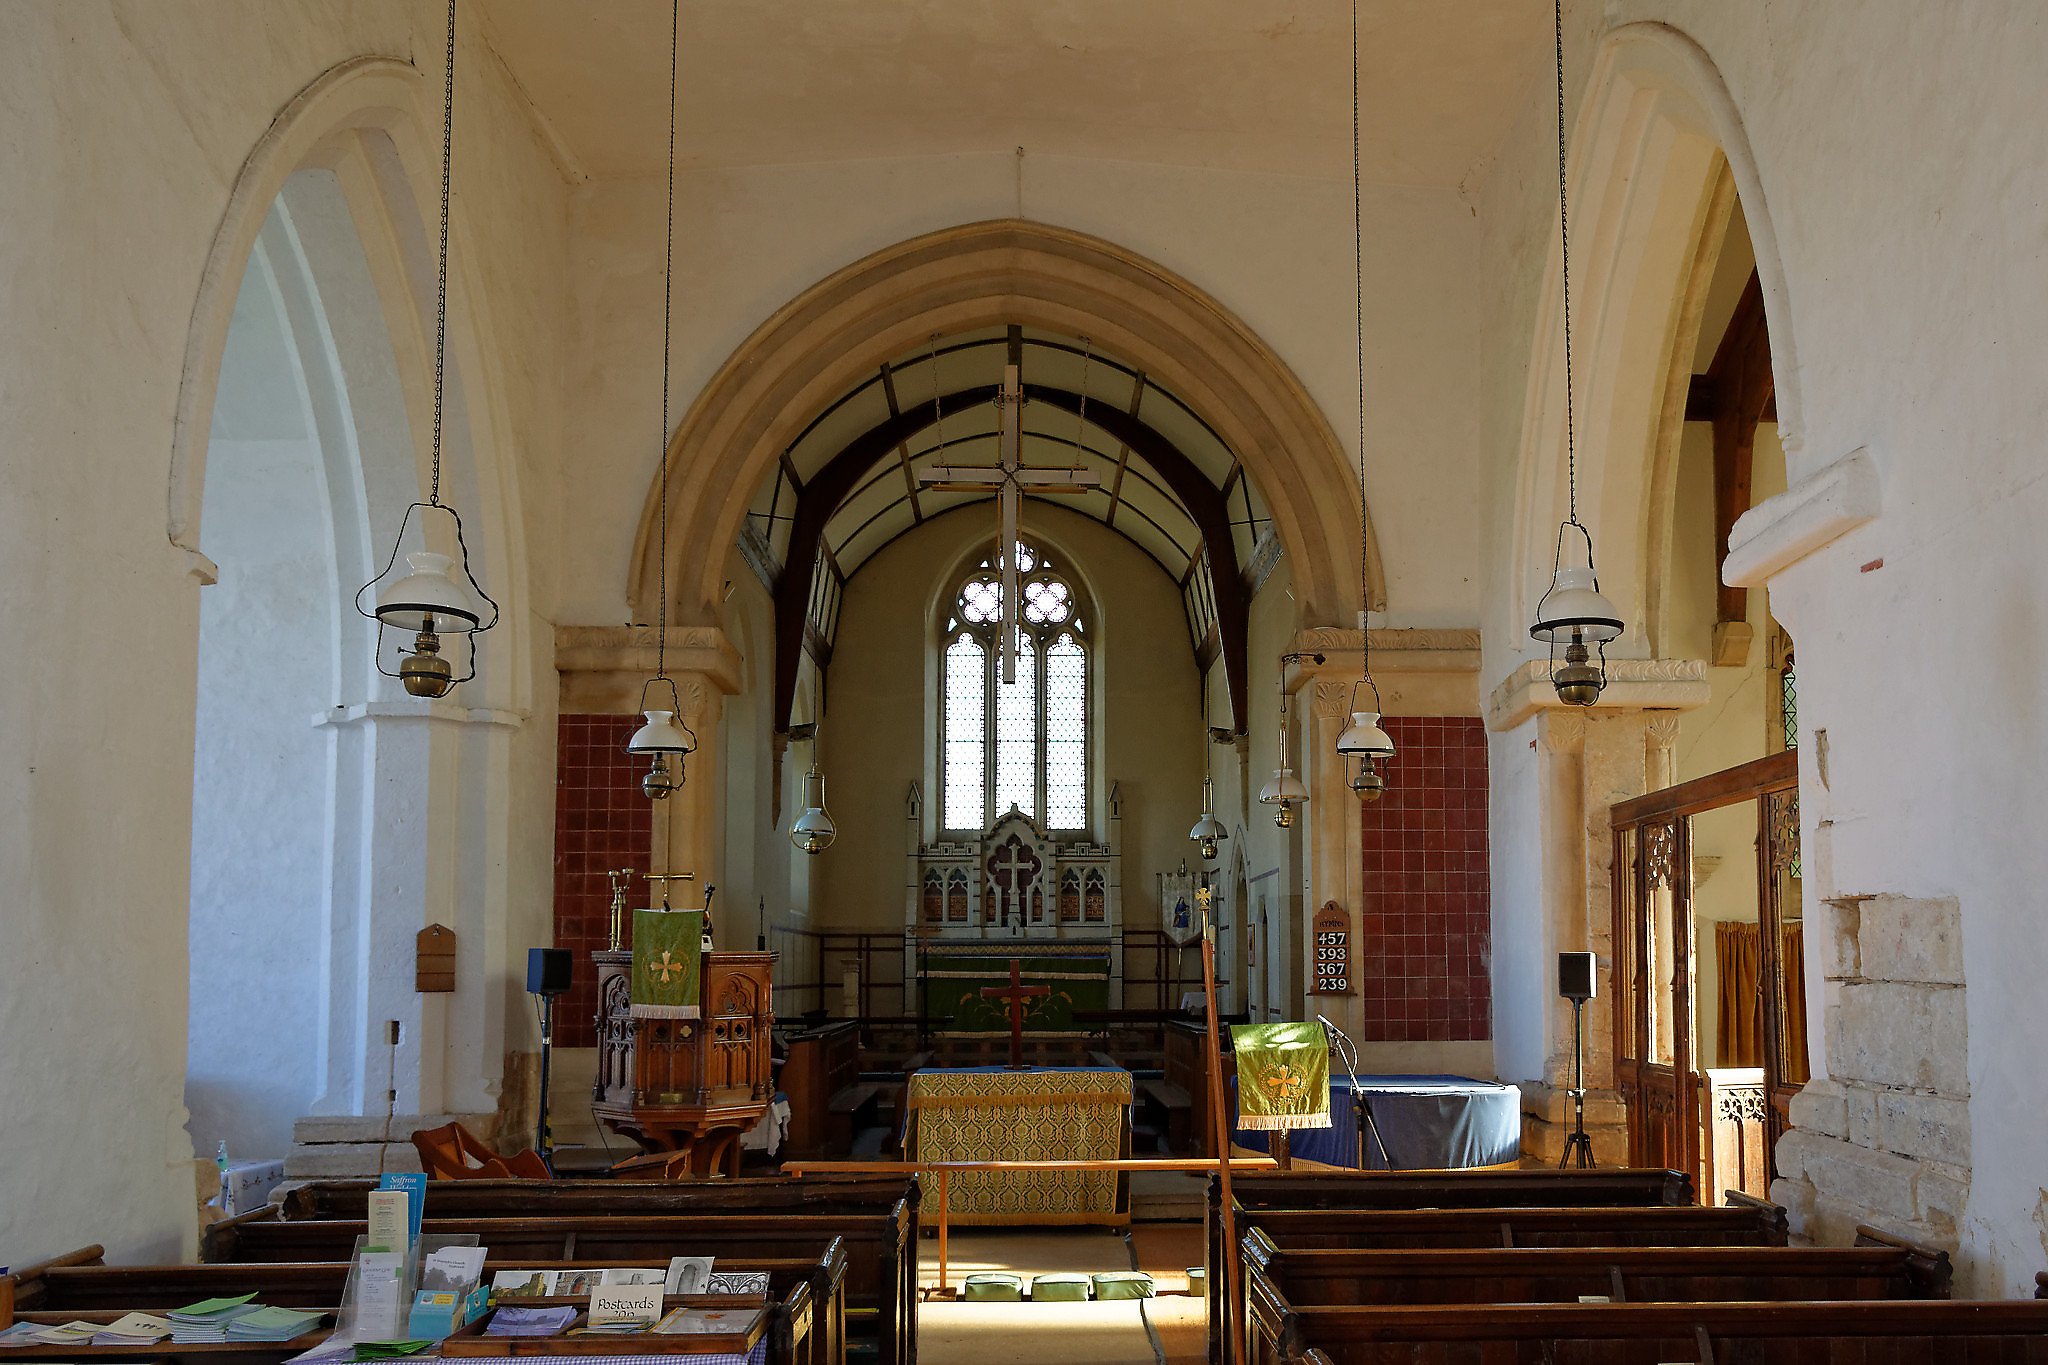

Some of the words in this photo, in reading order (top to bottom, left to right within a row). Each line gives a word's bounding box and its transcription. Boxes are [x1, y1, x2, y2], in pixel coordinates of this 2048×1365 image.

[1318, 932, 1346, 945] 457
[1317, 948, 1346, 960] 393
[1317, 963, 1345, 975] 367
[1319, 978, 1347, 990] 239
[390, 1175, 417, 1187] Saffron
[598, 1296, 654, 1311] Postcards
